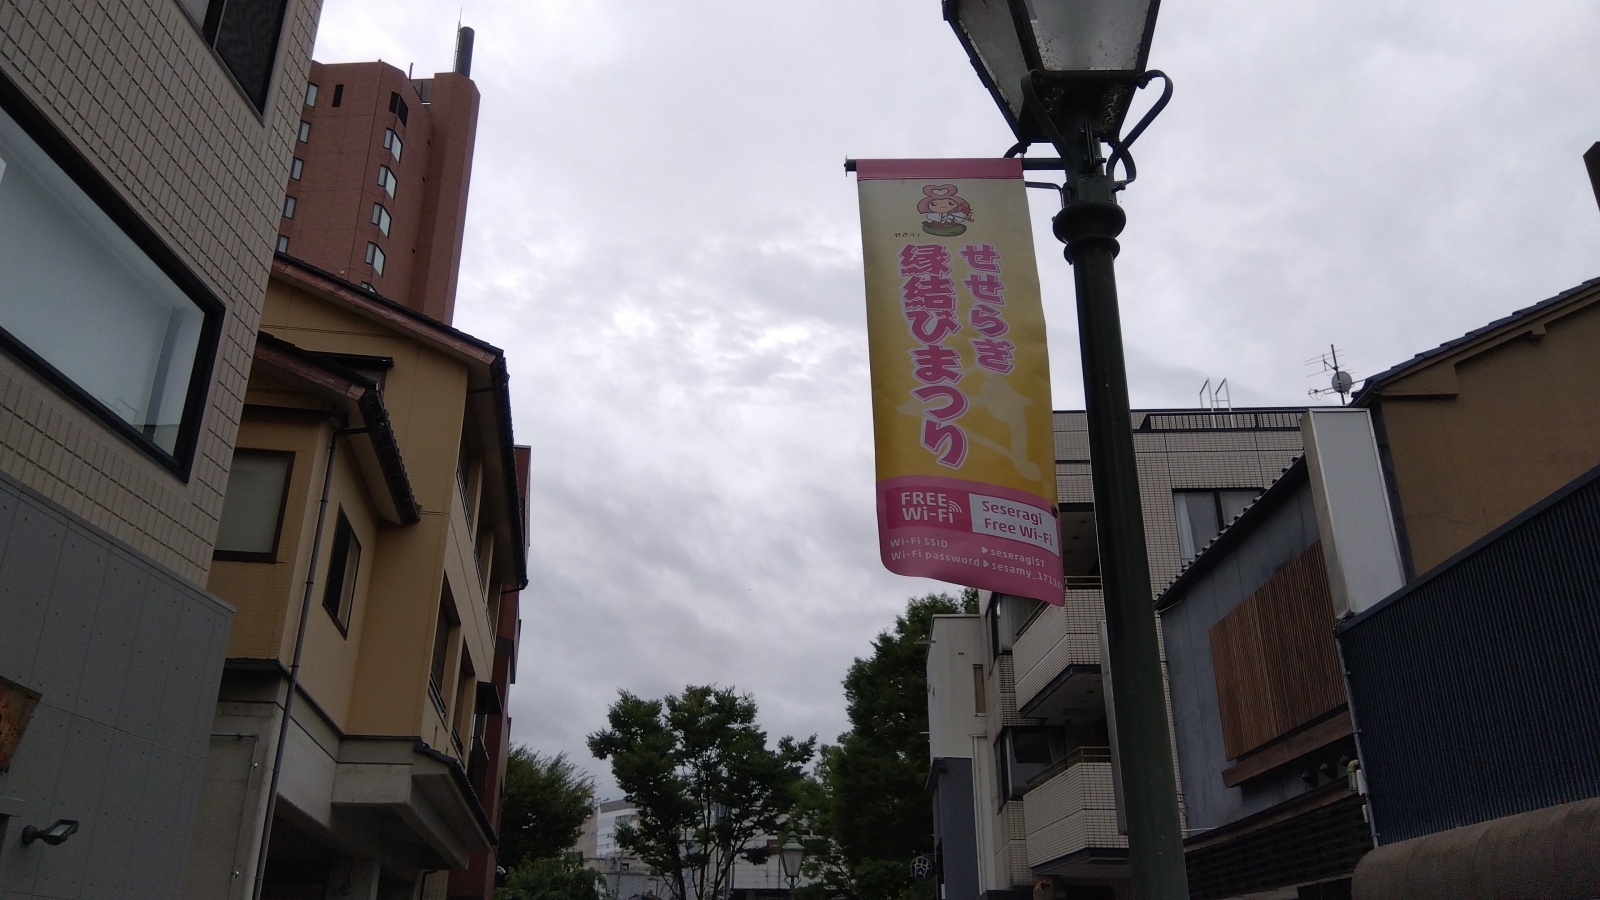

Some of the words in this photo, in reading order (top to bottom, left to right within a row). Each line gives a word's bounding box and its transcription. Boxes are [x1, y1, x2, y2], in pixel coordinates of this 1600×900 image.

[960, 243, 1016, 374] せせらぎ
[899, 243, 968, 469] 縁結びまつり
[901, 491, 948, 507] FREE
[902, 507, 954, 524] Wi-Fi
[982, 500, 1043, 526] Seseragi
[890, 536, 920, 548] Wi-Fi
[924, 537, 948, 548] SSID
[984, 517, 1016, 534] Free
[1019, 525, 1053, 547] Wi-Fi
[891, 549, 921, 561] Wi-Fi
[925, 551, 980, 567] password
[990, 548, 1046, 568] seseragiST
